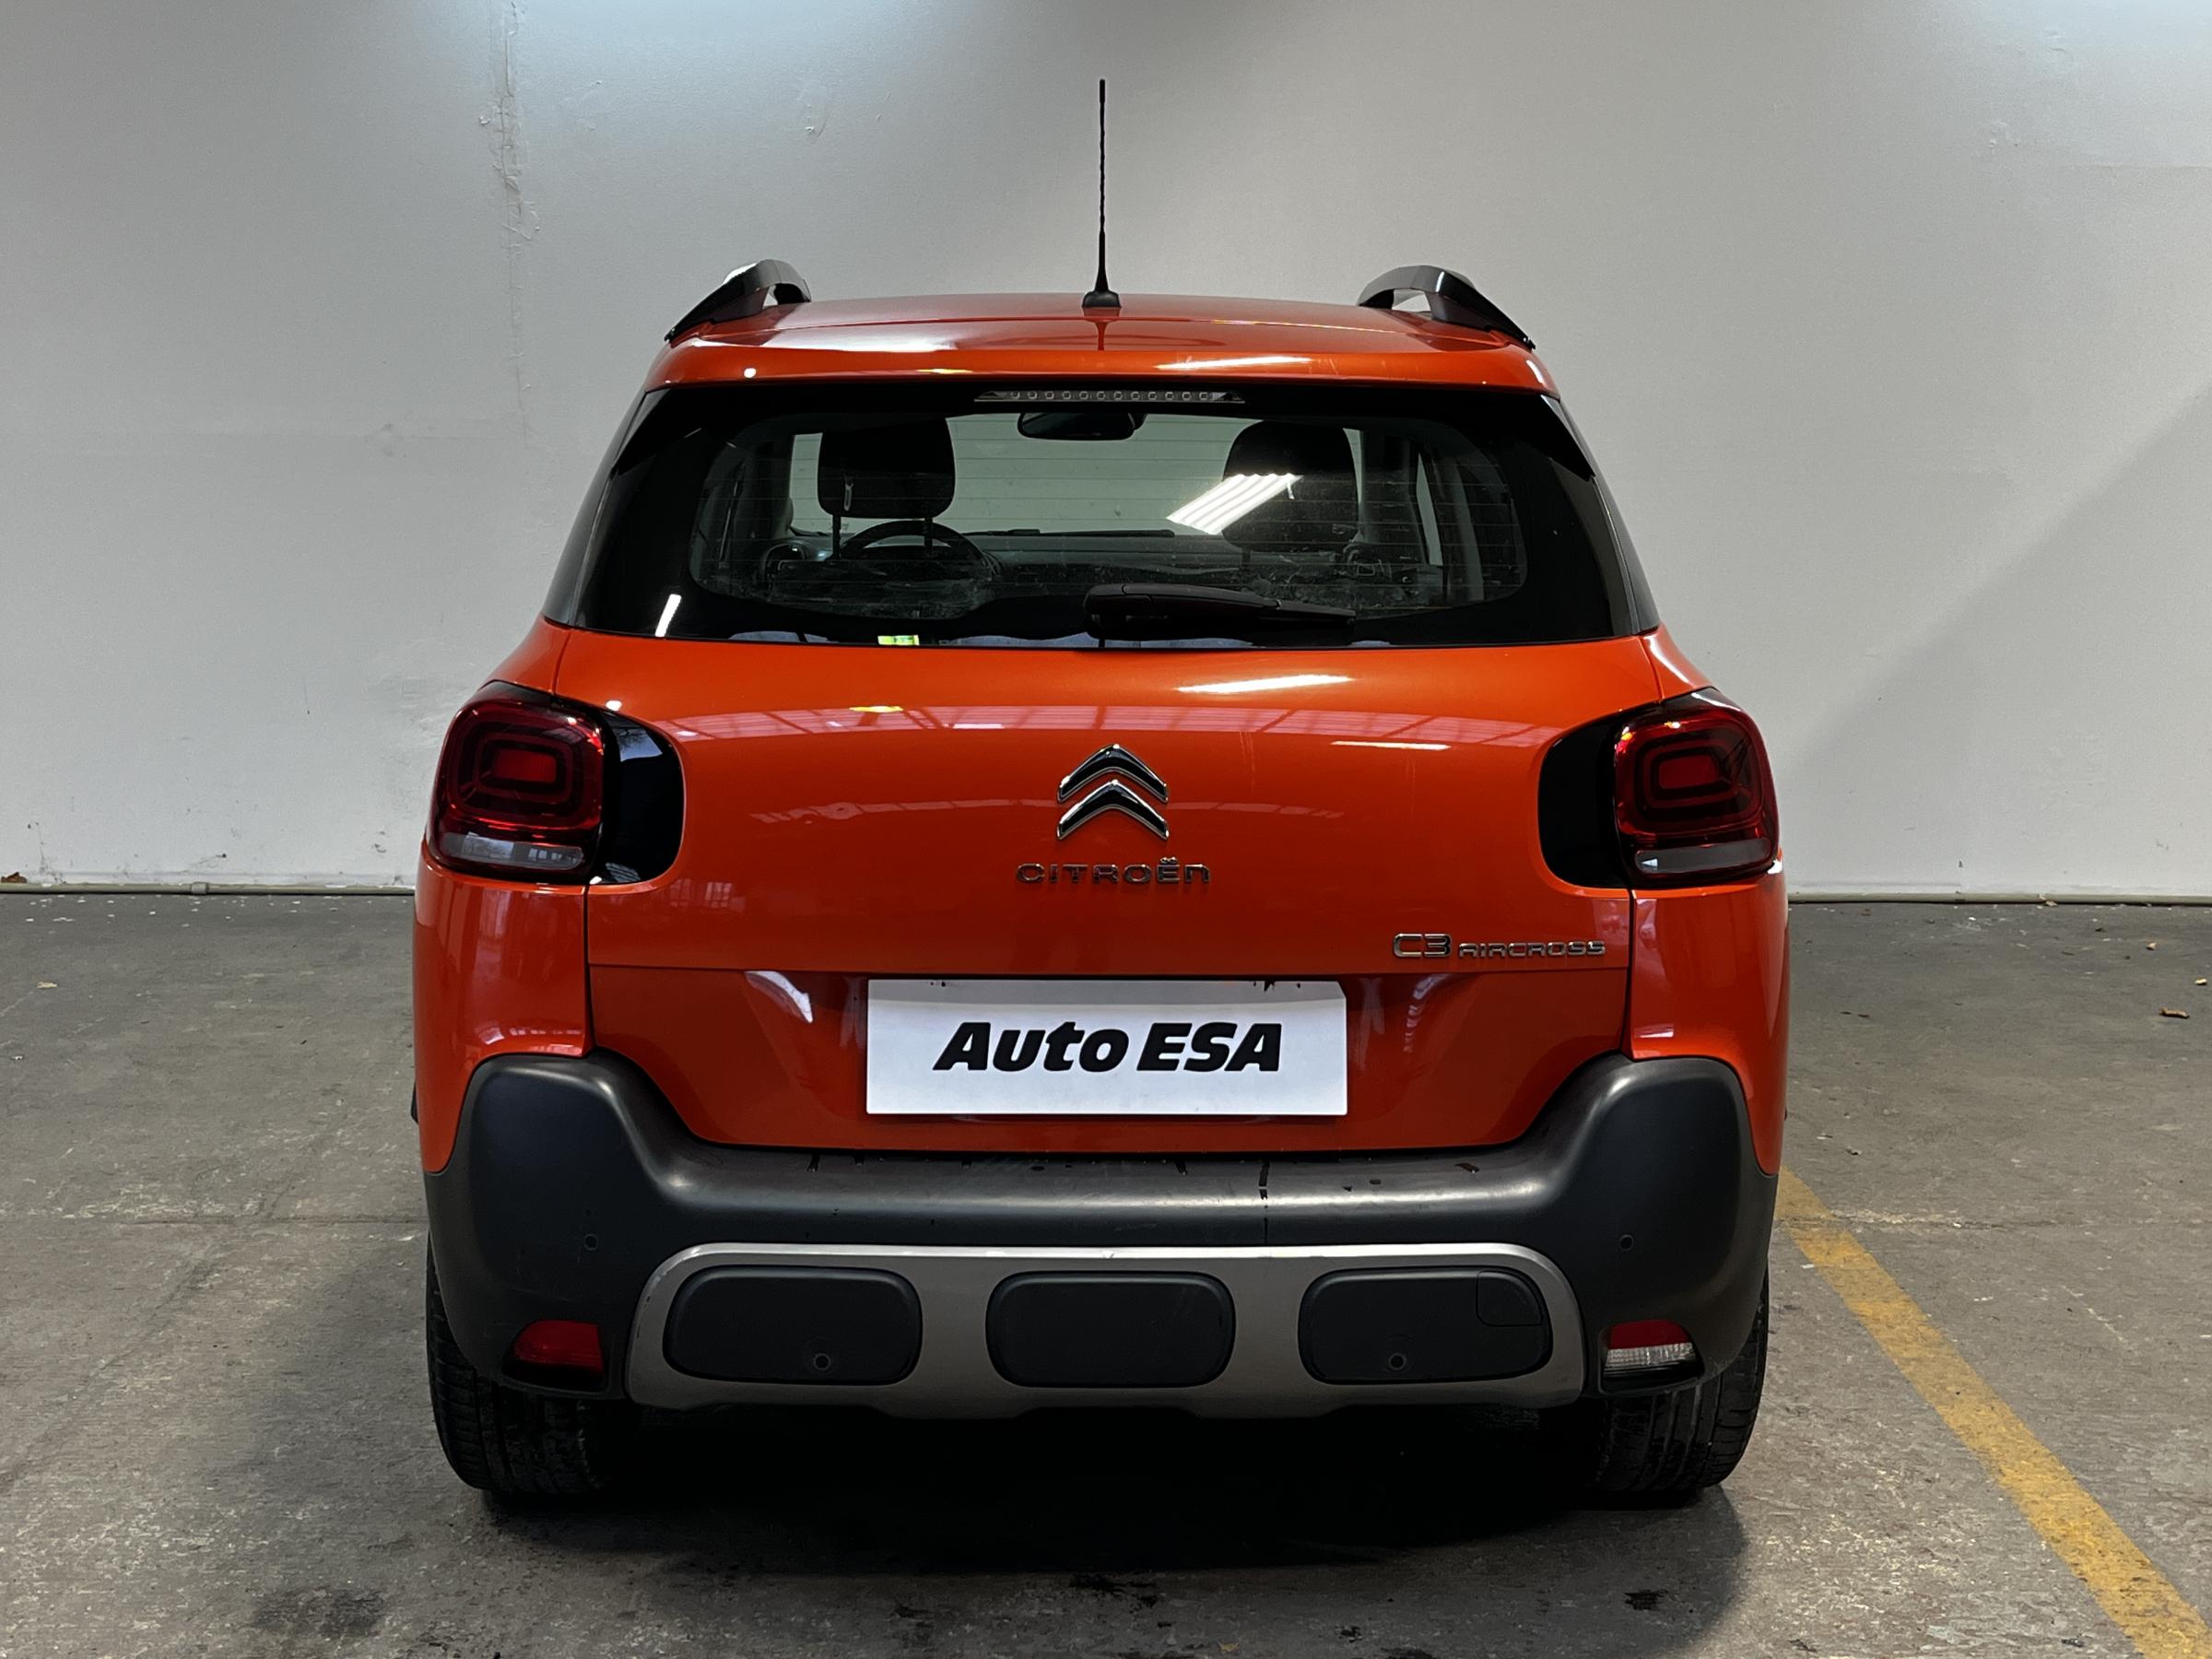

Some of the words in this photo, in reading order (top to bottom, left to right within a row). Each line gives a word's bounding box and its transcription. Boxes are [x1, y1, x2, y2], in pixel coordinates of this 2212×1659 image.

[1393, 933, 1452, 958] C3
[1459, 941, 1606, 959] AIRCROSS
[932, 1021, 1129, 1072] Auto
[1136, 1021, 1283, 1072] ESA
